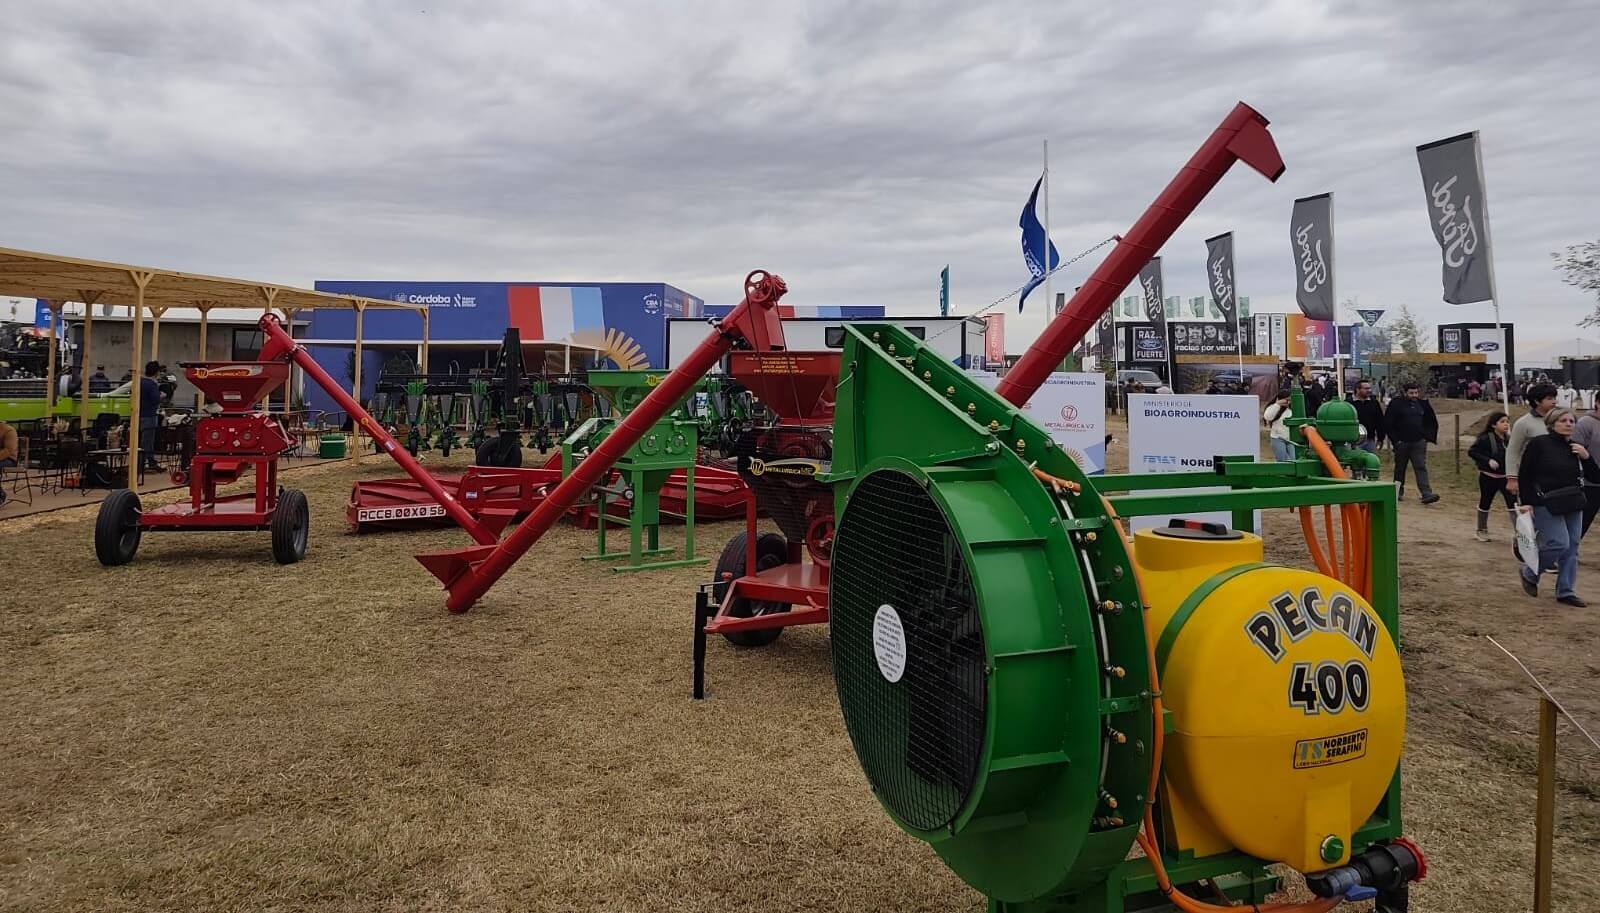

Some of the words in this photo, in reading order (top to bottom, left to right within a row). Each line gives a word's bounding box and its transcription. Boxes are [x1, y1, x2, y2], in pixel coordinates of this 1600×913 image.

[409, 294, 451, 304] Córdoba
[1138, 330, 1162, 339] RAZ
[1136, 350, 1164, 358] FUERTE
[1201, 345, 1214, 353] por
[1144, 409, 1241, 419] BIOAGROINDUSTRIA
[1180, 458, 1213, 467] NORB
[1244, 586, 1378, 664] PECAN
[1288, 659, 1370, 715] 400
[1323, 731, 1366, 749] NORBERTO
[1326, 742, 1362, 758] SERAFINI
